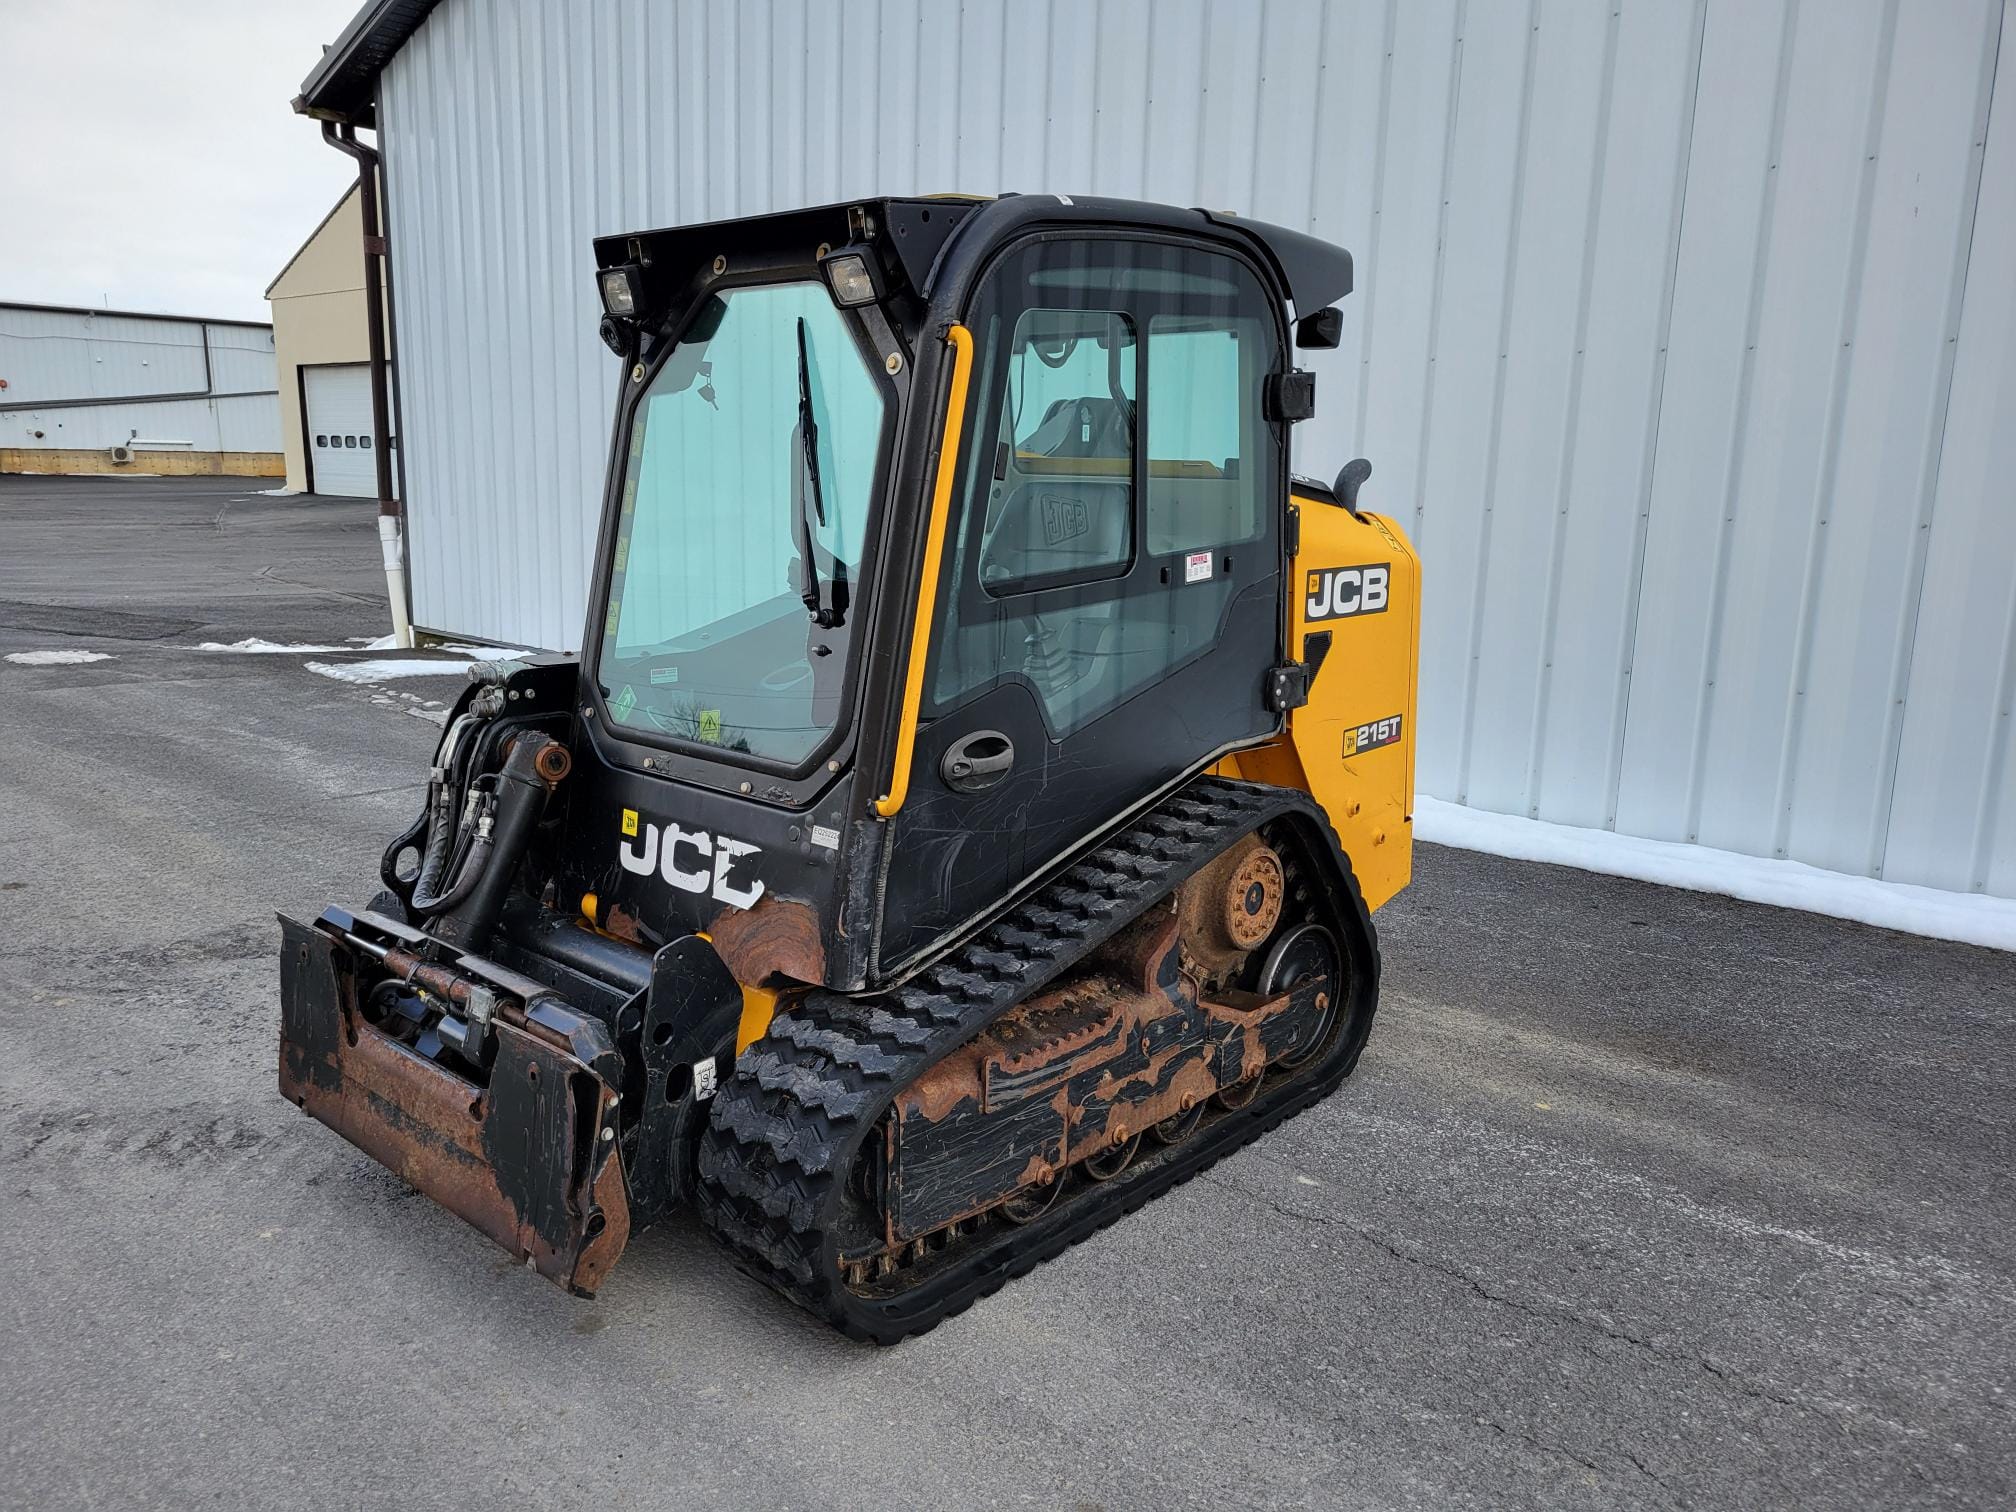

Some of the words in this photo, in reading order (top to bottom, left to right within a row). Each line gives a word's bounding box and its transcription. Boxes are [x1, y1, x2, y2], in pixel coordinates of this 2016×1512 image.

[1046, 499, 1085, 541] JCB
[1308, 568, 1388, 618] JCB
[1357, 716, 1401, 747] 215T
